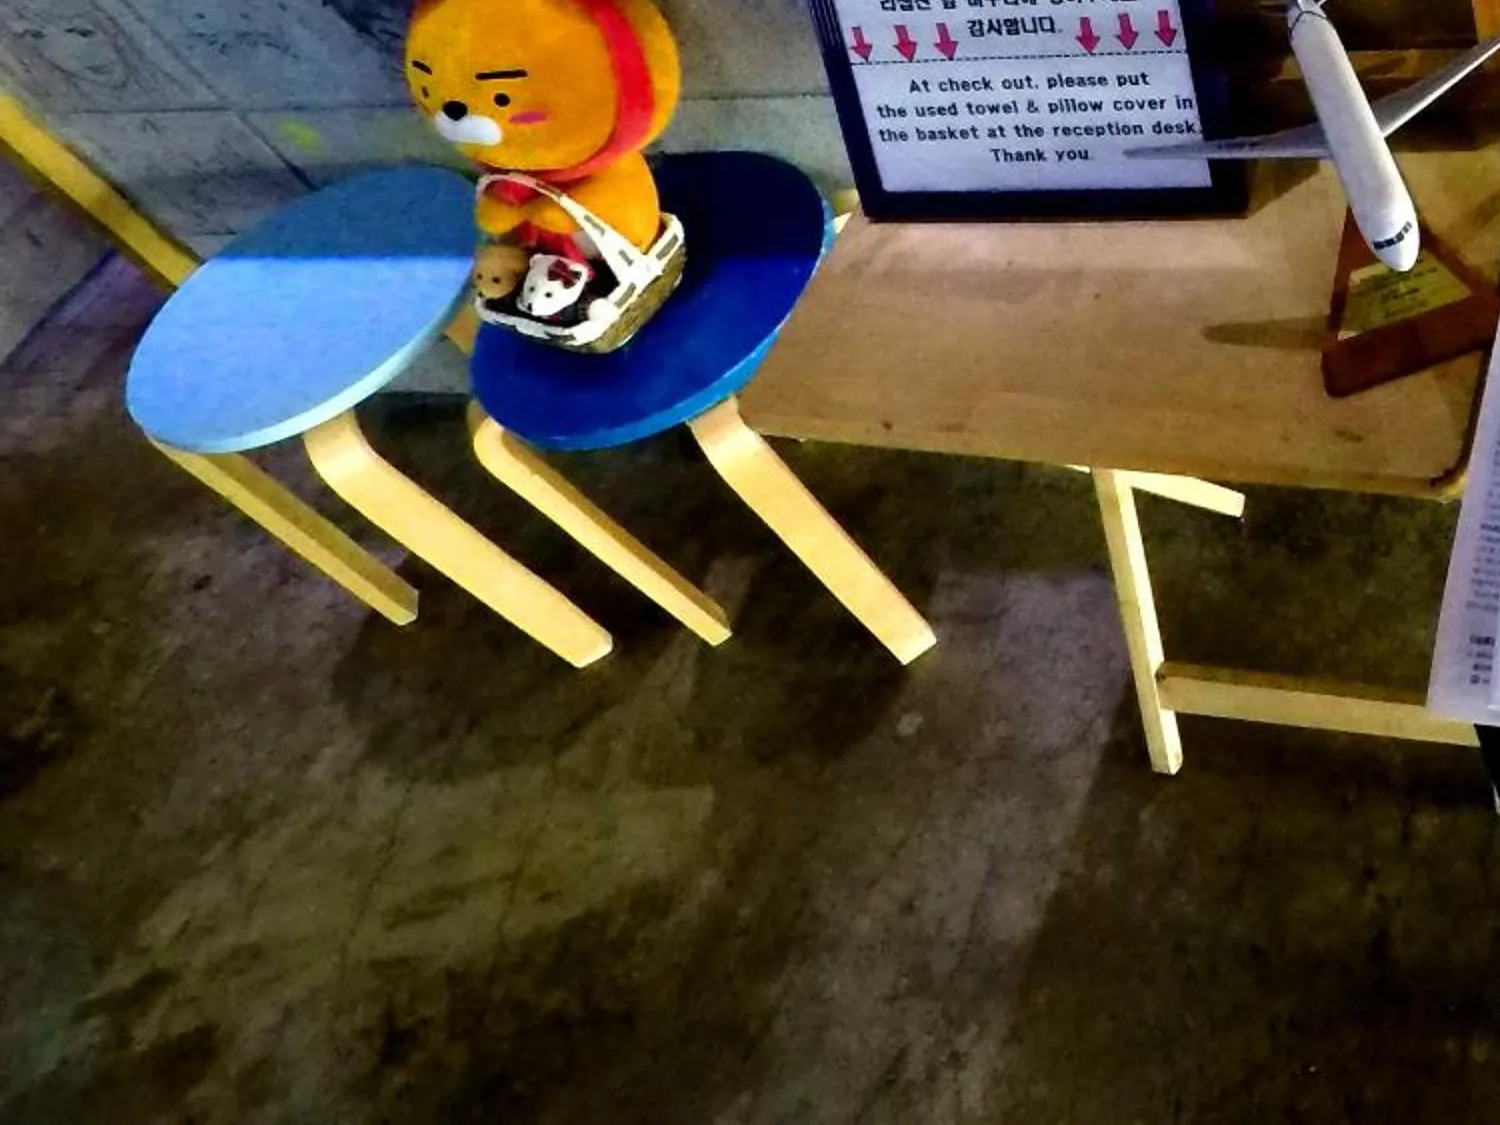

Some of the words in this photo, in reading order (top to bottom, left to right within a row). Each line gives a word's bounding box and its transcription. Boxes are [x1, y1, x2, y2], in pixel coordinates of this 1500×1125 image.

[909, 79, 930, 94] At
[938, 76, 993, 92] check
[1001, 75, 1039, 91] out,
[1047, 72, 1108, 90] please
[1117, 71, 1150, 88] put
[877, 104, 907, 119] the
[915, 102, 958, 117] used
[967, 100, 1018, 115] towel
[1026, 100, 1038, 113] &
[1047, 97, 1103, 114] pillow
[1112, 97, 1166, 111] cover
[1175, 95, 1193, 110] in
[879, 128, 908, 142] the
[915, 125, 978, 141] basket
[987, 126, 1005, 139] at
[1015, 123, 1044, 138] the
[1052, 121, 1144, 138] reception
[991, 148, 1045, 163] Thank
